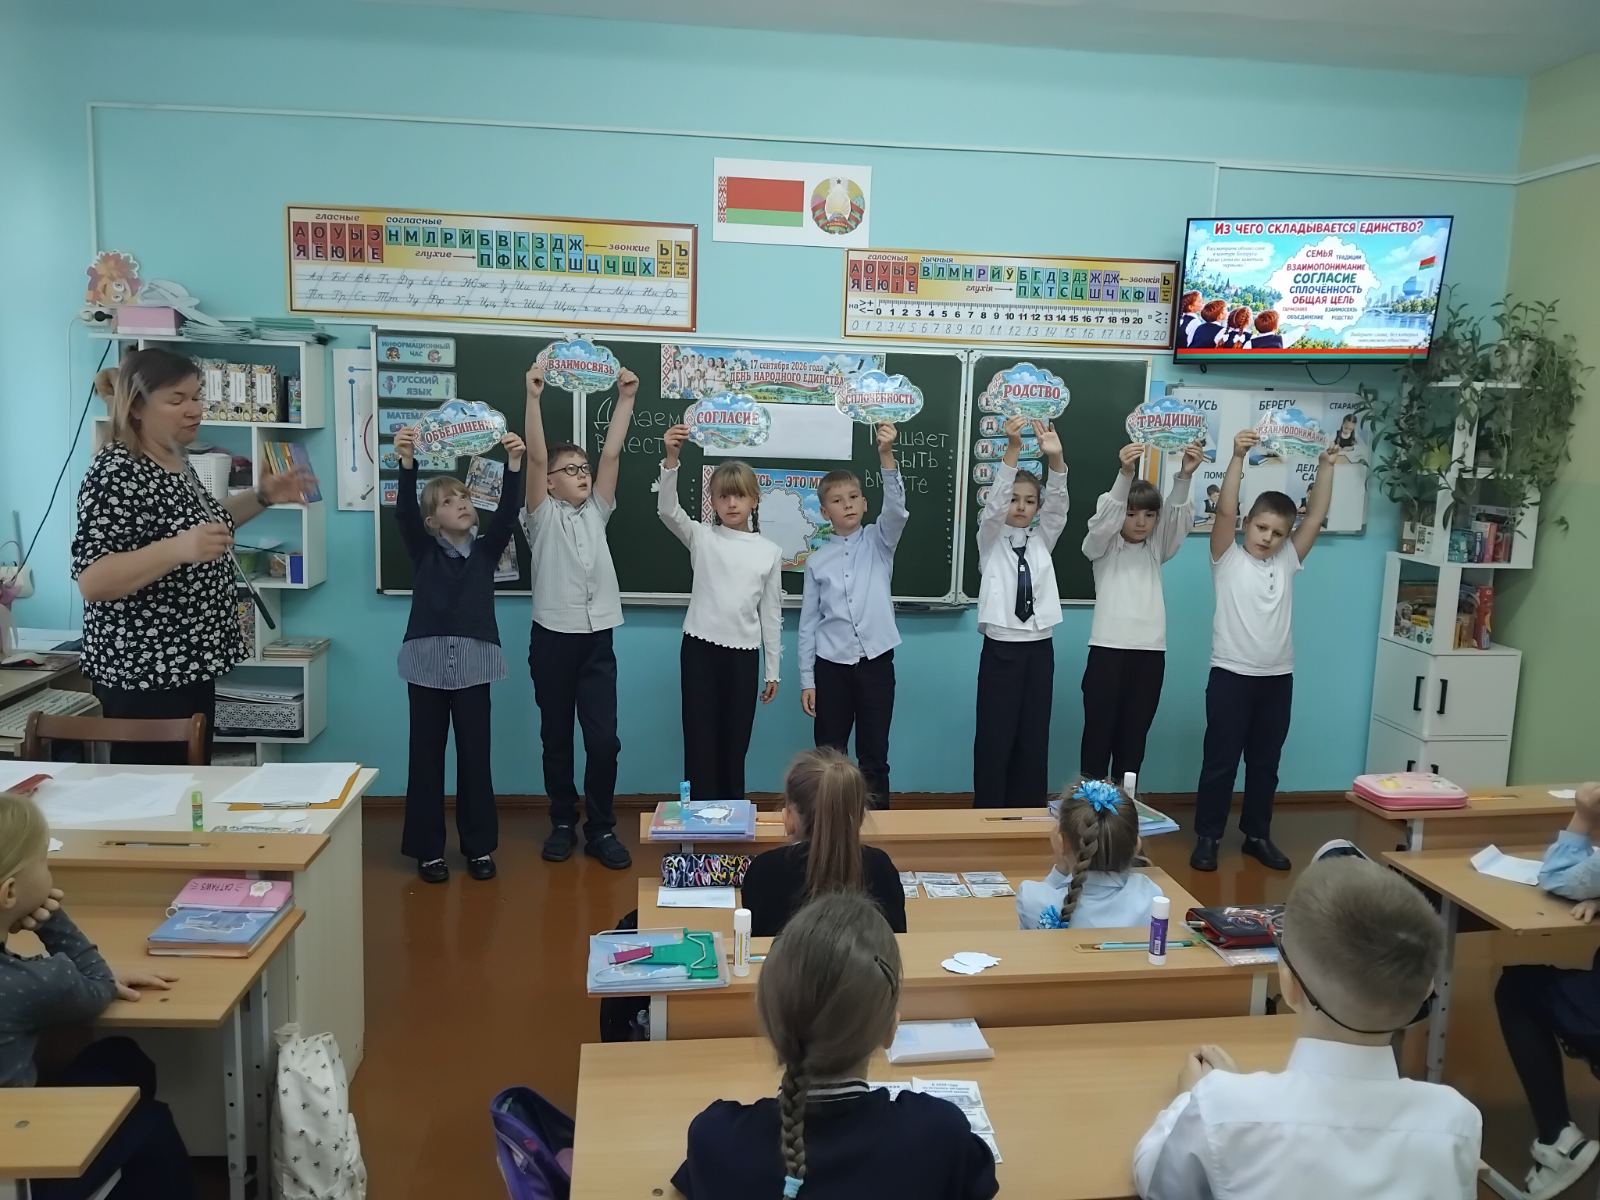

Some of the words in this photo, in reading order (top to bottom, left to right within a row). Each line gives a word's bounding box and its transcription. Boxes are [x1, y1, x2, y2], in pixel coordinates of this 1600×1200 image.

[316, 213, 360, 221] гласные
[386, 216, 442, 225] согласные
[296, 226, 305, 237] А
[314, 227, 325, 237] О
[334, 227, 343, 238] У
[351, 229, 362, 240] Ы
[371, 230, 380, 240] Э
[1235, 223, 1263, 234] ЧЕГО
[1268, 222, 1356, 235] СКЛАДЫВАЕТСЯ
[1360, 220, 1423, 234] ЕДИНСТВО?
[389, 231, 398, 241] Н
[406, 231, 417, 242] М
[426, 232, 435, 243] Л
[444, 233, 453, 244] Р
[462, 231, 472, 245] Й
[481, 235, 490, 245] Б
[499, 235, 508, 246] В
[519, 236, 526, 247] Г
[535, 237, 544, 248] З
[553, 238, 563, 252] Д
[569, 239, 583, 250] Ж
[609, 242, 650, 252] звонкие
[296, 245, 306, 256] Я
[315, 244, 324, 257] Ё
[331, 246, 344, 258] Ю
[353, 247, 363, 259] И
[372, 248, 380, 259] Е
[415, 250, 452, 259] глухие
[660, 244, 669, 255] Ь
[676, 245, 688, 256] Ъ
[1306, 249, 1334, 258] СЕМЬЯ
[480, 254, 491, 266] П
[498, 254, 510, 266] Ф
[517, 255, 527, 267] К
[535, 256, 544, 268] С
[554, 257, 563, 269] Т
[569, 259, 583, 270] Ш
[588, 259, 599, 274] Ц
[606, 260, 616, 271] Ч
[623, 261, 636, 276] Щ
[642, 262, 651, 274] Х
[852, 264, 859, 273] А
[866, 265, 874, 274] О
[882, 265, 888, 274] У
[894, 266, 903, 275] Ы
[908, 267, 916, 275] Э
[1286, 263, 1365, 271] ВЗАИМОПОНИМАНИЕ
[922, 267, 930, 276] В
[937, 268, 944, 277] Л
[950, 268, 959, 277] М
[964, 269, 972, 278] Н
[978, 270, 985, 278] Р
[992, 268, 1000, 279] Й
[1019, 271, 1027, 279] Б
[1035, 271, 1040, 280] Г
[1047, 272, 1055, 282] Д
[1062, 272, 1069, 281] З
[1073, 272, 1087, 282] ДЗ
[1090, 273, 1101, 283] Ж
[1104, 273, 1120, 284] ДЖ
[1163, 277, 1170, 285] Ь
[1293, 272, 1356, 284] СОГЛАСИЕ
[851, 280, 860, 289] Я
[866, 277, 873, 289] Ё
[878, 280, 889, 290] Ю
[909, 282, 916, 291] Е
[1289, 284, 1362, 294] СПЛОЧЁННОСТЬ
[1018, 287, 1027, 296] П
[1033, 287, 1040, 296] Х
[1048, 287, 1055, 296] Т
[1060, 288, 1068, 297] С
[1075, 288, 1084, 299] Ц
[1089, 289, 1100, 299] Ш
[1106, 290, 1114, 299] Ч
[1122, 290, 1129, 299] К
[1134, 290, 1144, 300] Ф
[1148, 291, 1157, 301] Ц
[1292, 295, 1327, 305] ОБЩАЯ
[1330, 295, 1355, 305] ЦЕЛЬ
[382, 341, 450, 350] ИНФОРМАЦИОННЫЙ
[548, 360, 614, 375] ВЗАИМОСВЯЗЬ
[750, 360, 758, 370] 17
[760, 361, 789, 372] сентября
[791, 362, 807, 372] 2026
[809, 363, 824, 372] года
[397, 376, 439, 384] РУССКИЙ
[730, 371, 751, 382] ДЕНЬ
[753, 372, 801, 382] НАРОДНОГО
[803, 373, 845, 386] ЕДИНСТВА
[1003, 384, 1060, 398] РОДСТВО
[845, 392, 915, 405] СПЛОЧЁННОСТЬ
[696, 412, 760, 426] СОГЛАСИЕ
[1138, 413, 1201, 428] ТРАДИЦИИ
[892, 449, 938, 468] ыть
[786, 475, 806, 488] ЭТО
